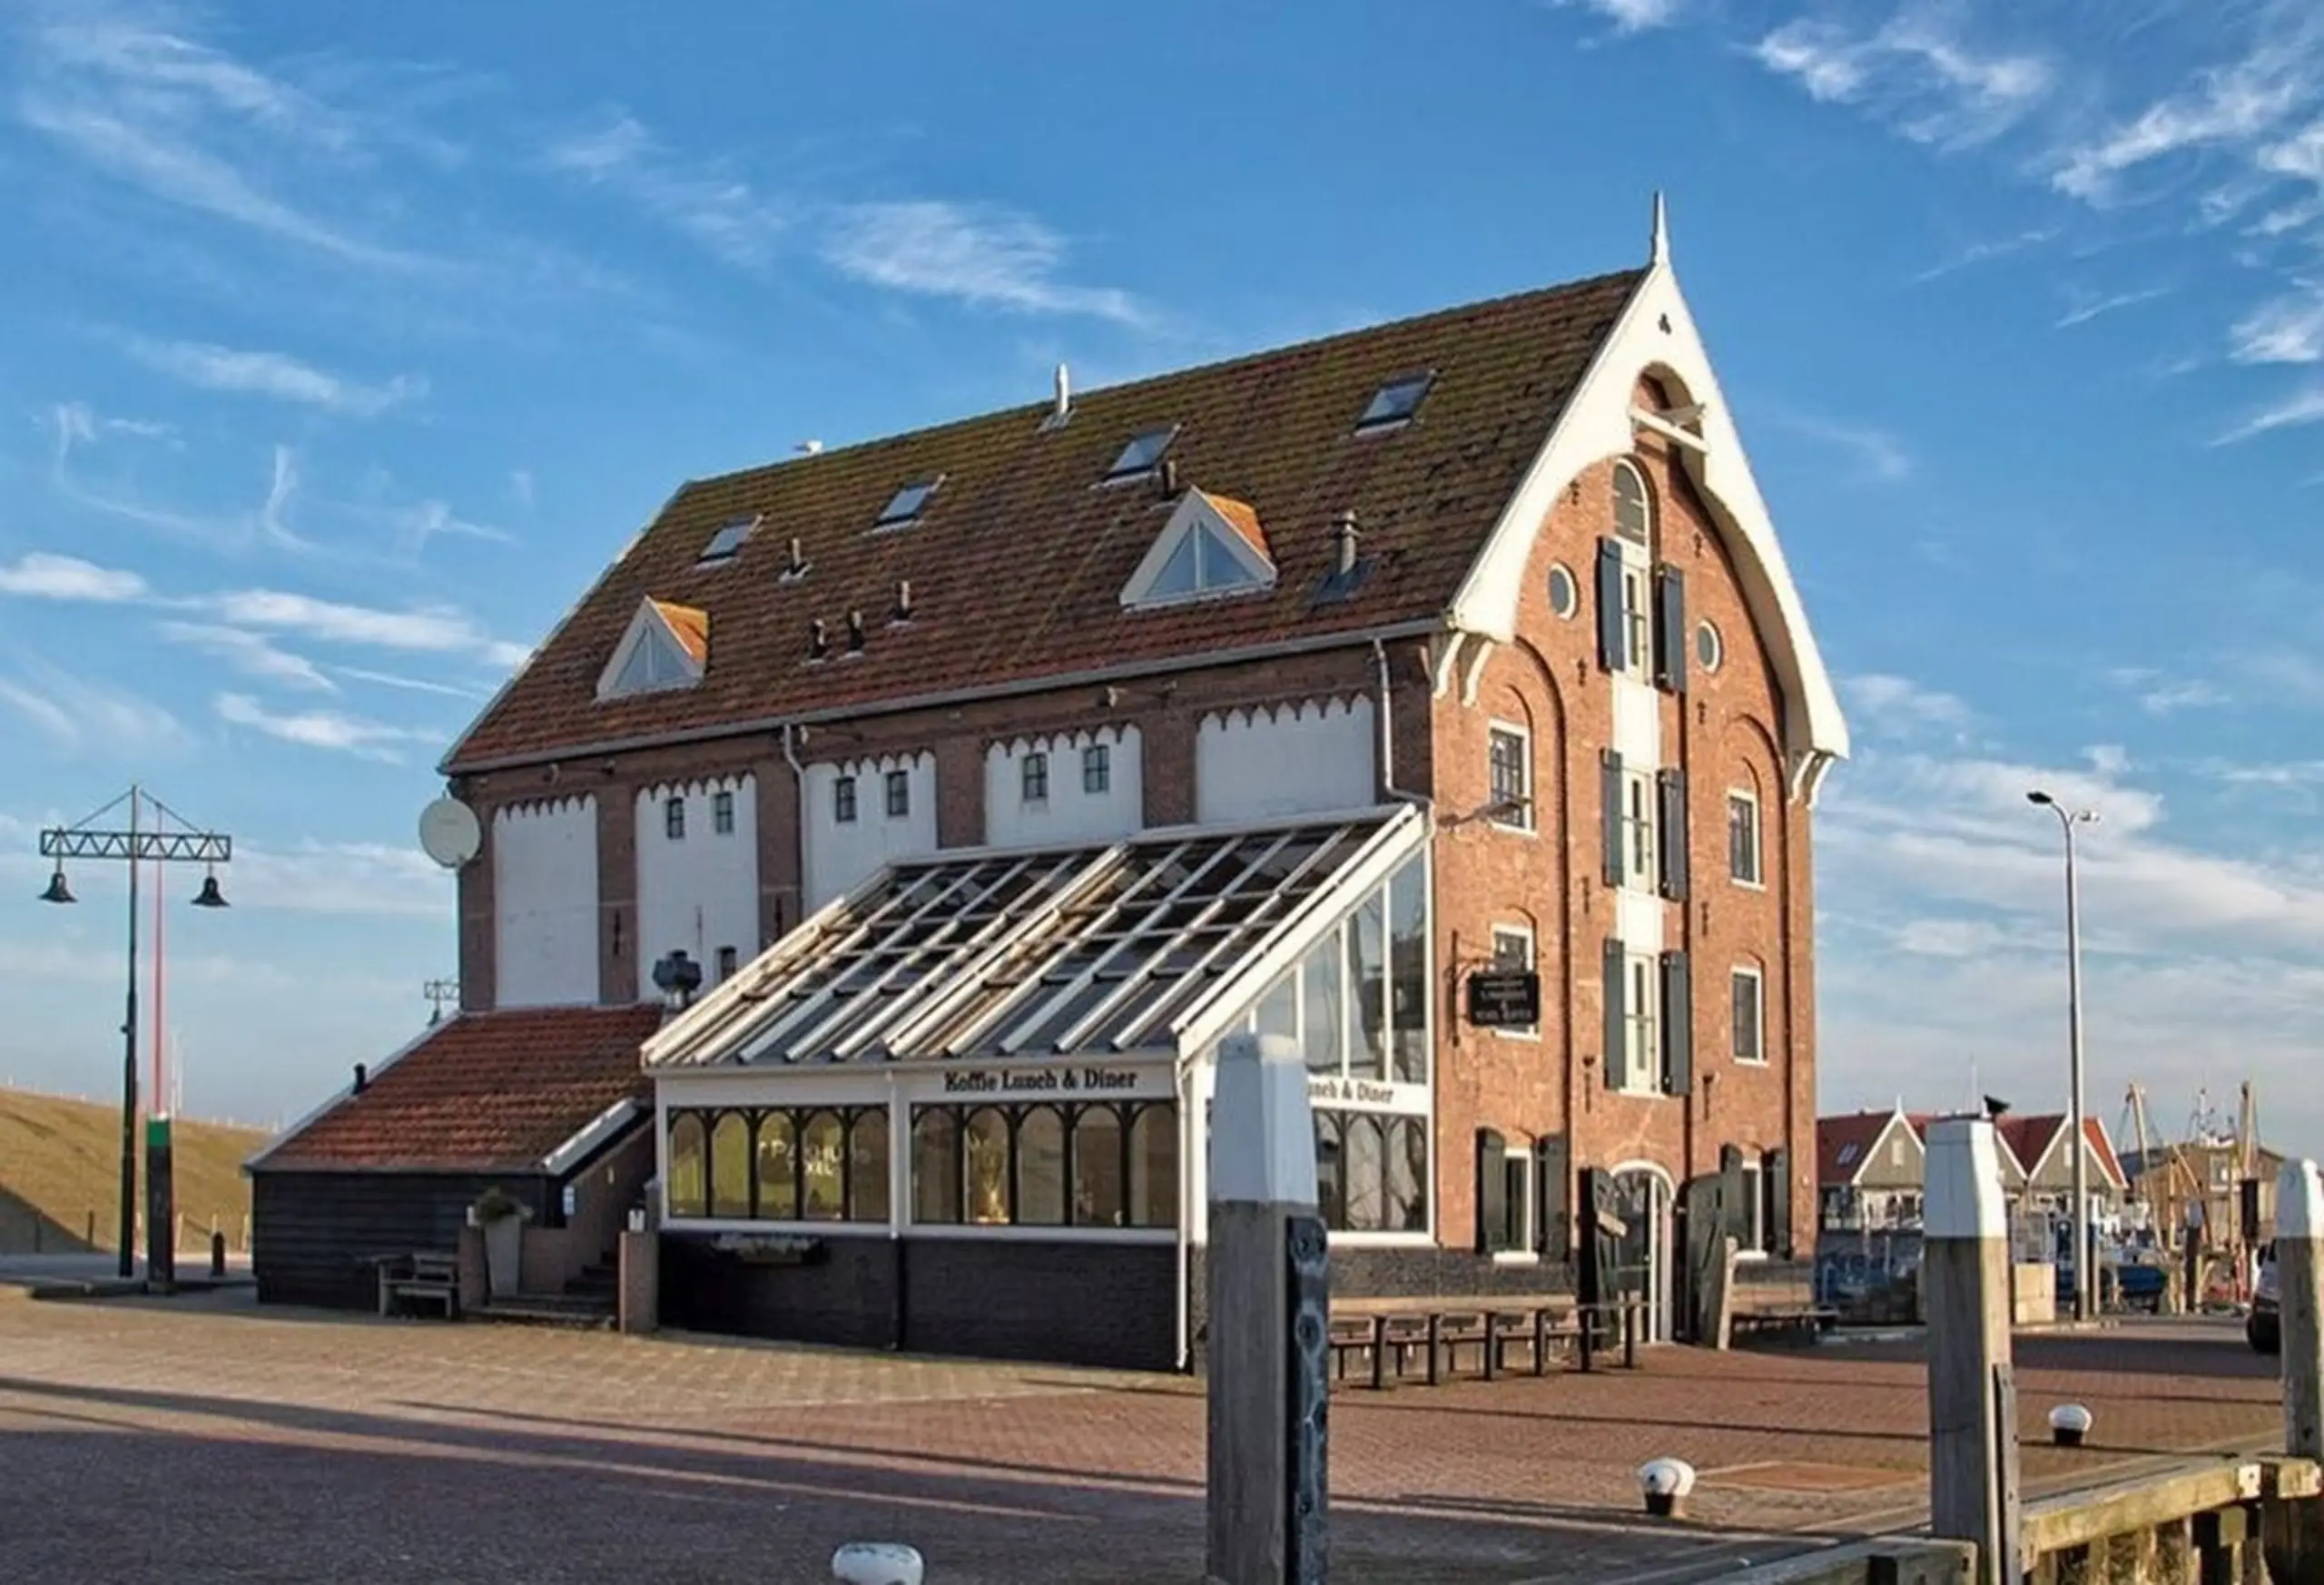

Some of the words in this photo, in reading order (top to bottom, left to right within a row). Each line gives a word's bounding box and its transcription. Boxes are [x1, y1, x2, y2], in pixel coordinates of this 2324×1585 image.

[944, 1070, 997, 1091] Koffie
[1002, 1068, 1058, 1089] Lunch
[1063, 1068, 1077, 1089] &
[1085, 1068, 1137, 1089] Diner
[1357, 1081, 1393, 1105] Diner
